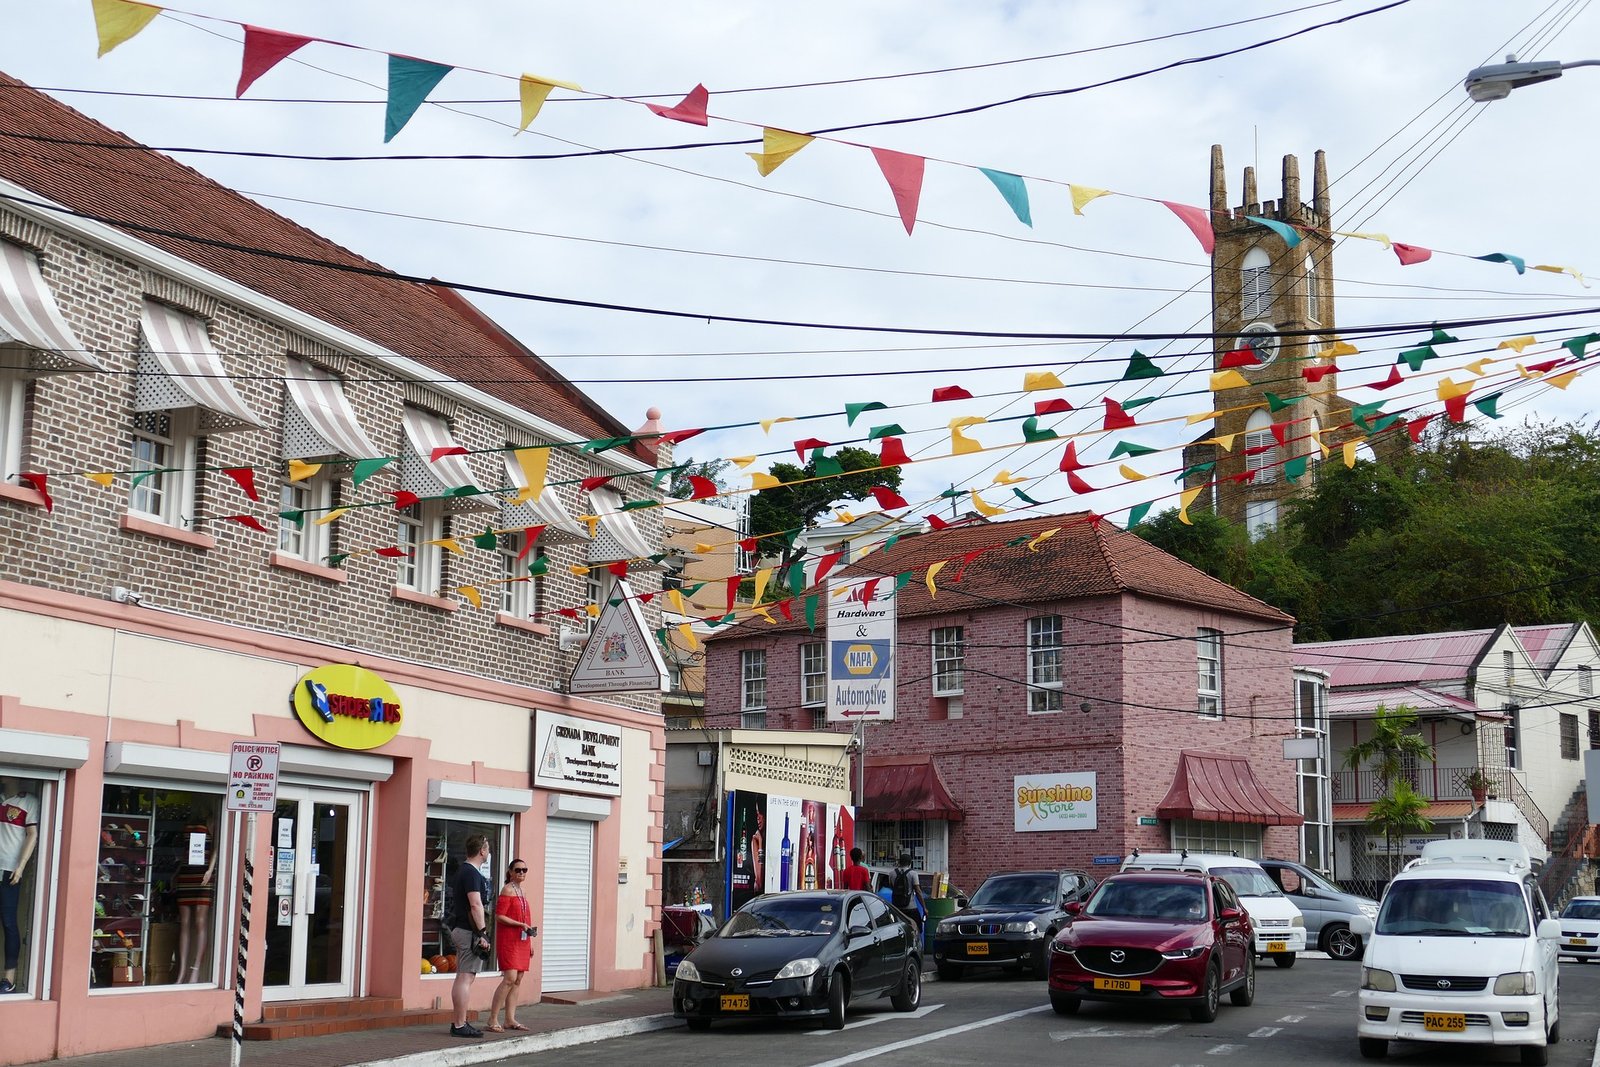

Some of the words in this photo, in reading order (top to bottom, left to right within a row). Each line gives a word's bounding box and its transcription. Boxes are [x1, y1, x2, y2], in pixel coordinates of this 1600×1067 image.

[837, 609, 886, 618] Hardware
[622, 612, 649, 664] DEVELOPMENT
[856, 624, 868, 637] &
[587, 625, 607, 661] GRENADA
[850, 652, 872, 667] NAPA
[836, 684, 887, 706] Automotive
[327, 693, 371, 719] SHOES
[383, 702, 401, 723] US
[555, 725, 581, 740] GRENADA
[582, 730, 620, 747] DEVELOPMENT
[233, 745, 255, 753] POLICE
[256, 746, 278, 754] NOTICE
[581, 743, 596, 756] BANK
[233, 771, 243, 779] NO
[244, 772, 274, 780] PARKING
[1018, 783, 1093, 804] Sunshine
[1038, 798, 1075, 819] Store
[721, 998, 749, 1008] P7473
[1425, 1016, 1444, 1027] PAC
[1446, 1017, 1464, 1029] 255
